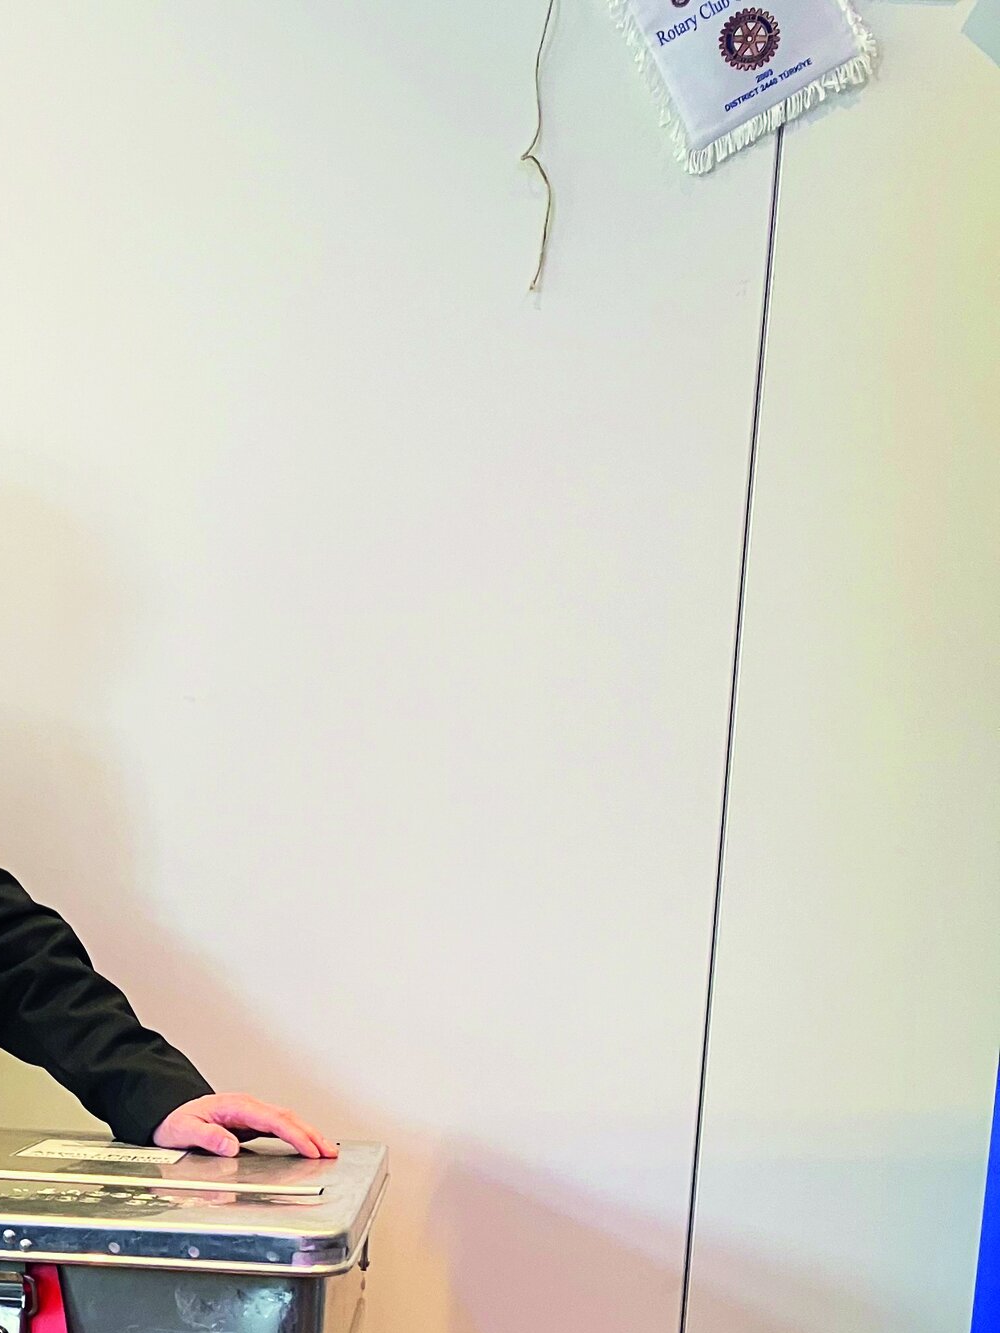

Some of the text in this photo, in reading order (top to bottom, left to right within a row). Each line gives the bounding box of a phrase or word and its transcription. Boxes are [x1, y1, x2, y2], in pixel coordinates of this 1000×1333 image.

[656, 0, 730, 46] Rotary Club
[725, 87, 759, 112] DISTRICT
